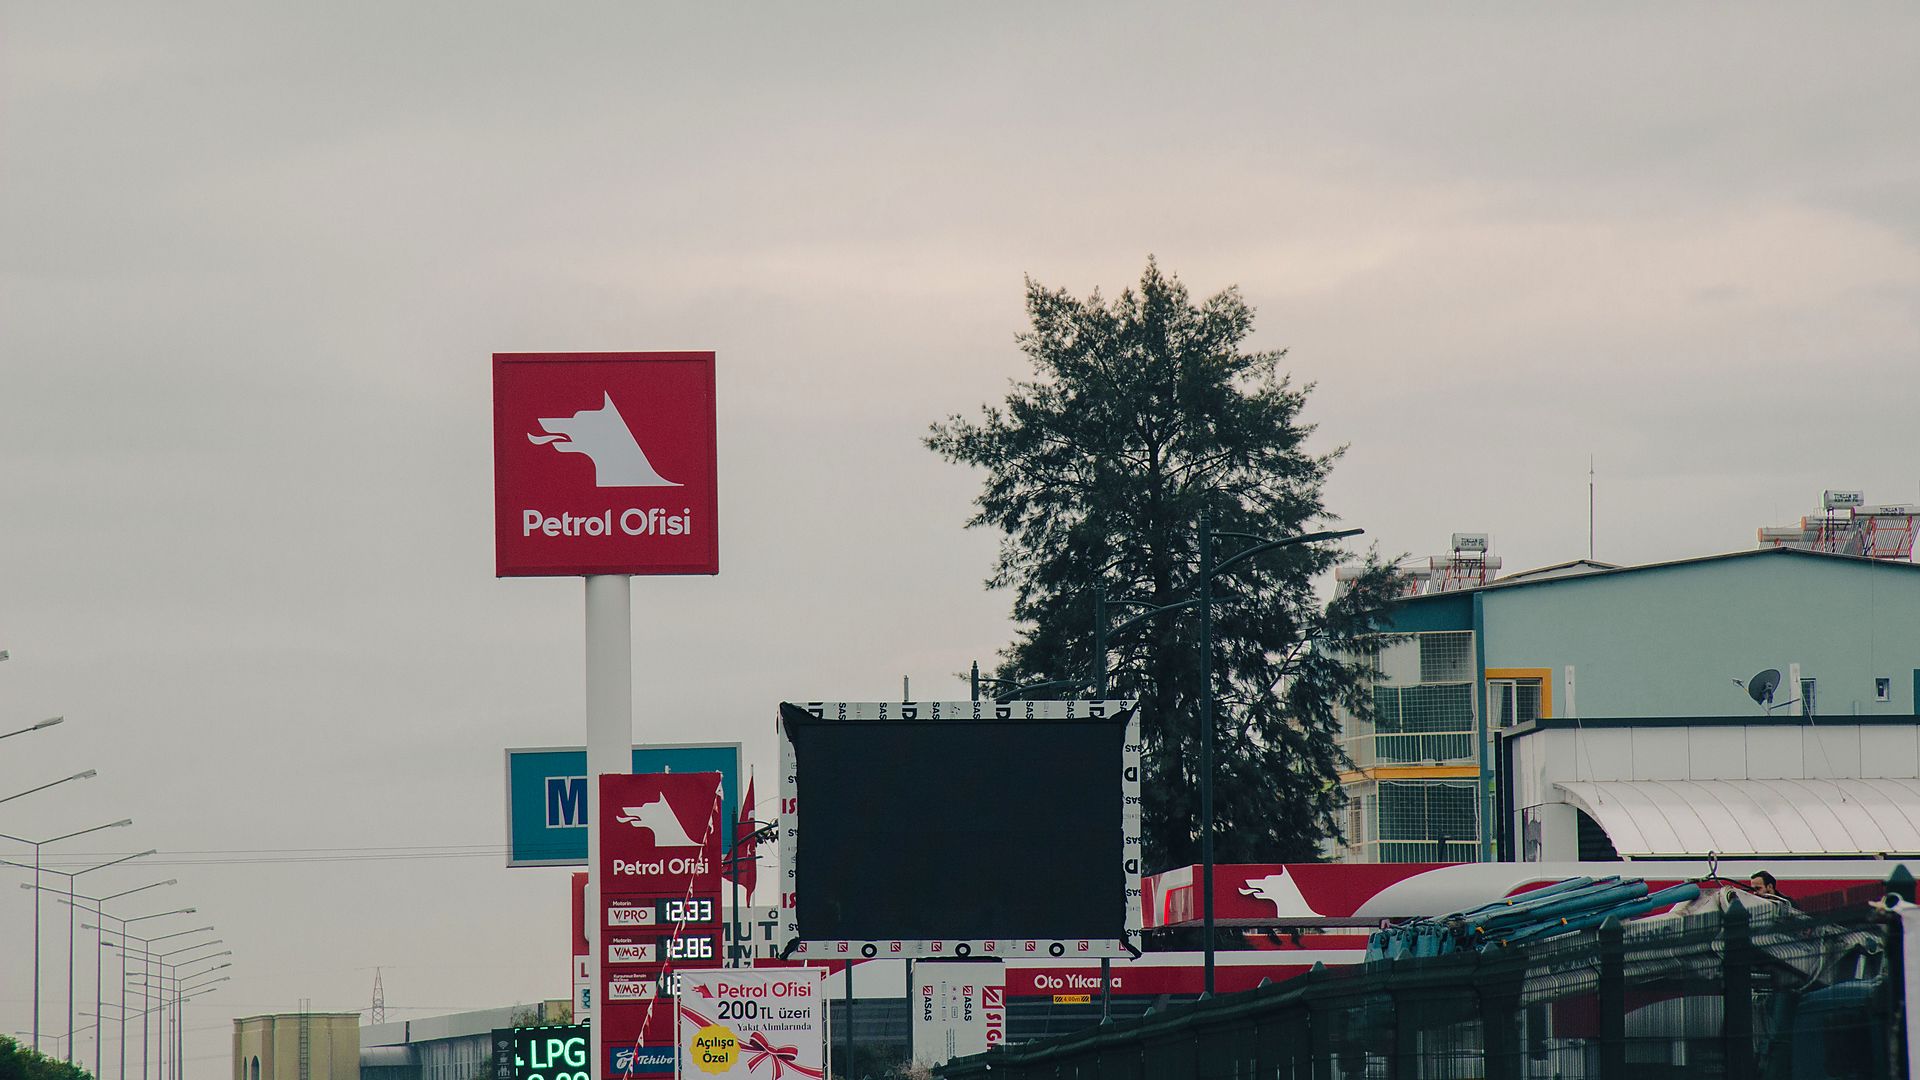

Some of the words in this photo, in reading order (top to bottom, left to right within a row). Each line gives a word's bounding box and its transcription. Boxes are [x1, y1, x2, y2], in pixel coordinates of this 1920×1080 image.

[523, 508, 612, 537] Petrol
[620, 507, 691, 536] Ofisi
[545, 776, 588, 828] M
[613, 859, 664, 875] Petrol
[668, 857, 709, 875] Ofisi
[666, 938, 712, 958] 12.86
[718, 982, 767, 998] Petrol
[772, 981, 811, 997] Ofisi
[1034, 974, 1063, 989] Oto
[778, 1007, 810, 1019] üzeri
[924, 996, 932, 1022] ASAS
[964, 996, 972, 1022] ASAS
[737, 1022, 759, 1032] Yakıt
[761, 1022, 812, 1031] Alımlarında
[696, 1037, 734, 1049] Açılışa
[530, 1037, 586, 1069] LPG
[638, 1055, 674, 1065] Tchibo
[702, 1050, 729, 1063] Özel
